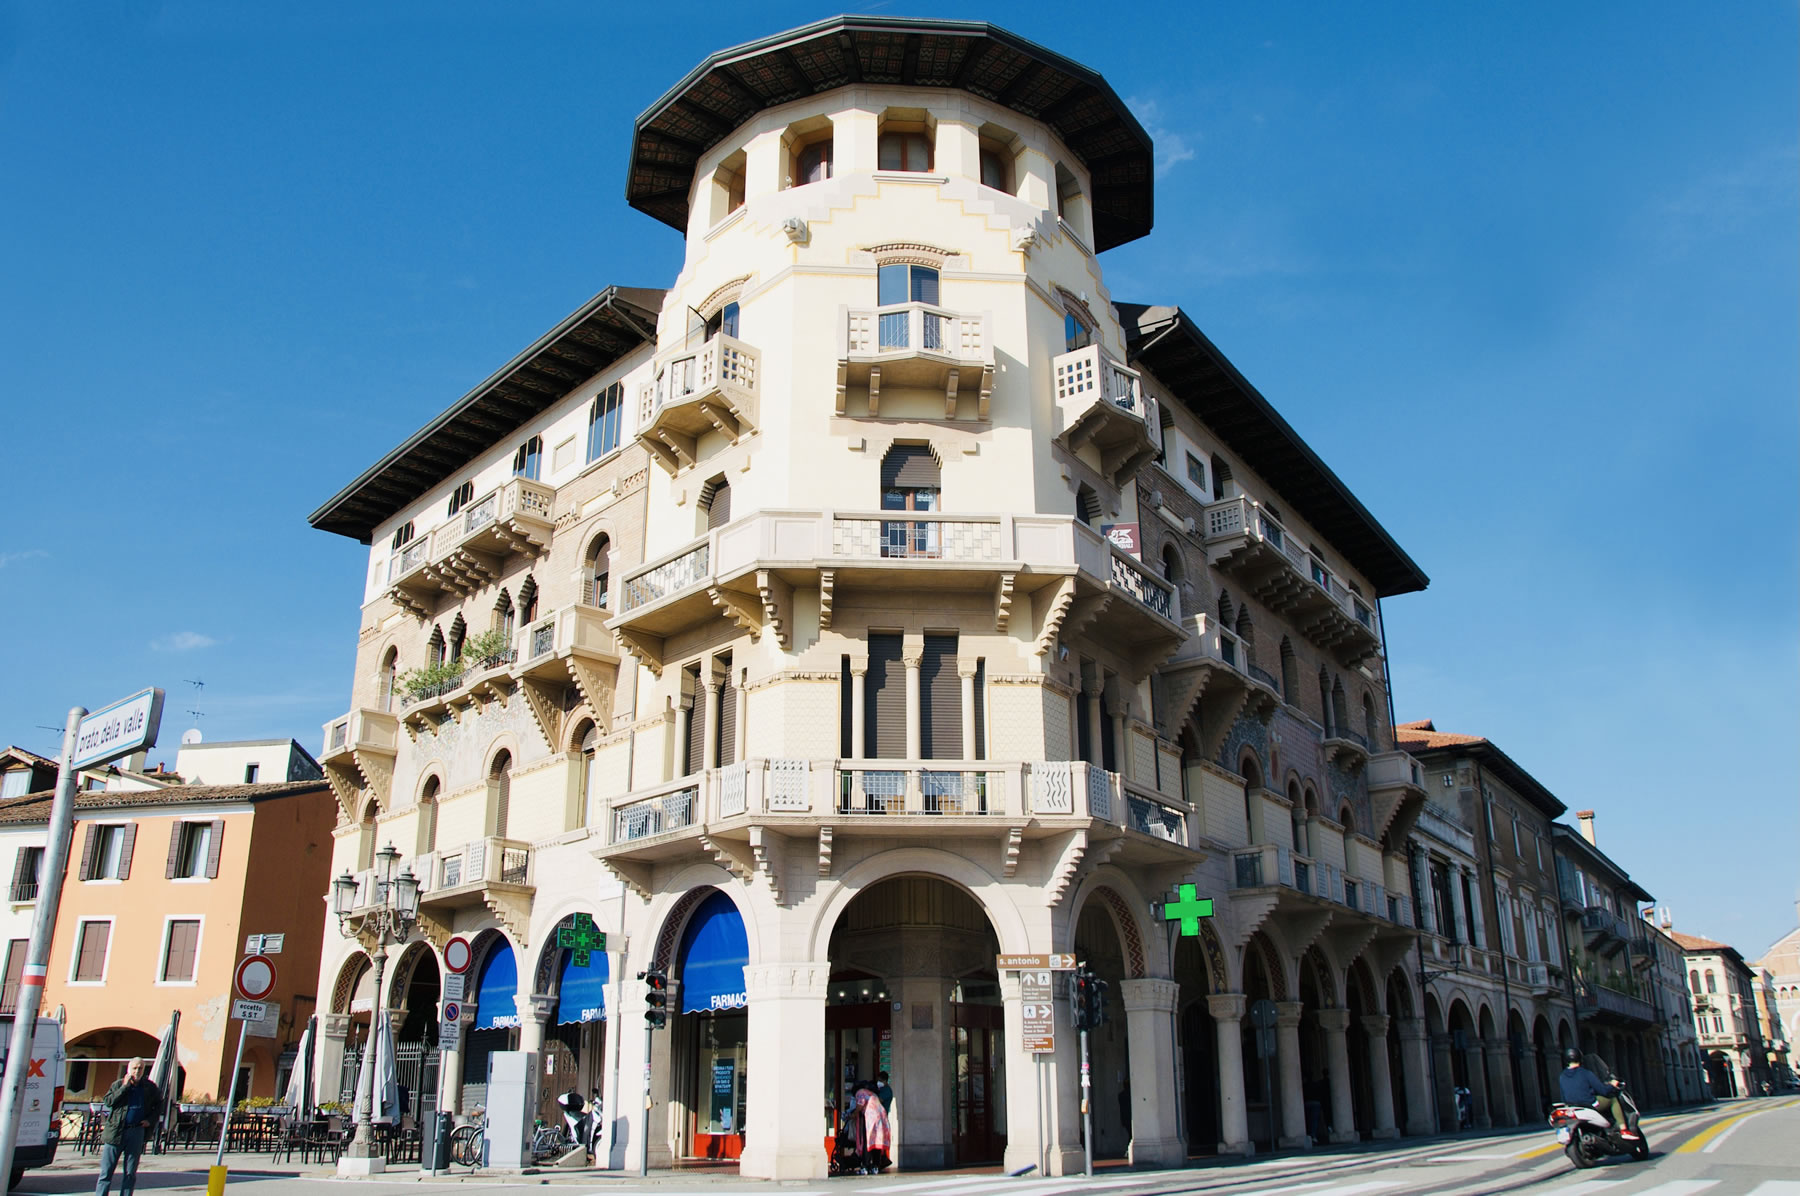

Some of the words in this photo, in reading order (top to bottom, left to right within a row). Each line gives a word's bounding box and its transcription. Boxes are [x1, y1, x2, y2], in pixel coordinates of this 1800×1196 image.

[79, 727, 99, 755] prato
[101, 717, 120, 744] della
[123, 708, 144, 735] valle
[1007, 956, 1041, 965] antonio
[711, 992, 747, 1008] FARMAC
[239, 1003, 262, 1012] eccetto
[581, 1007, 606, 1020] FARMA
